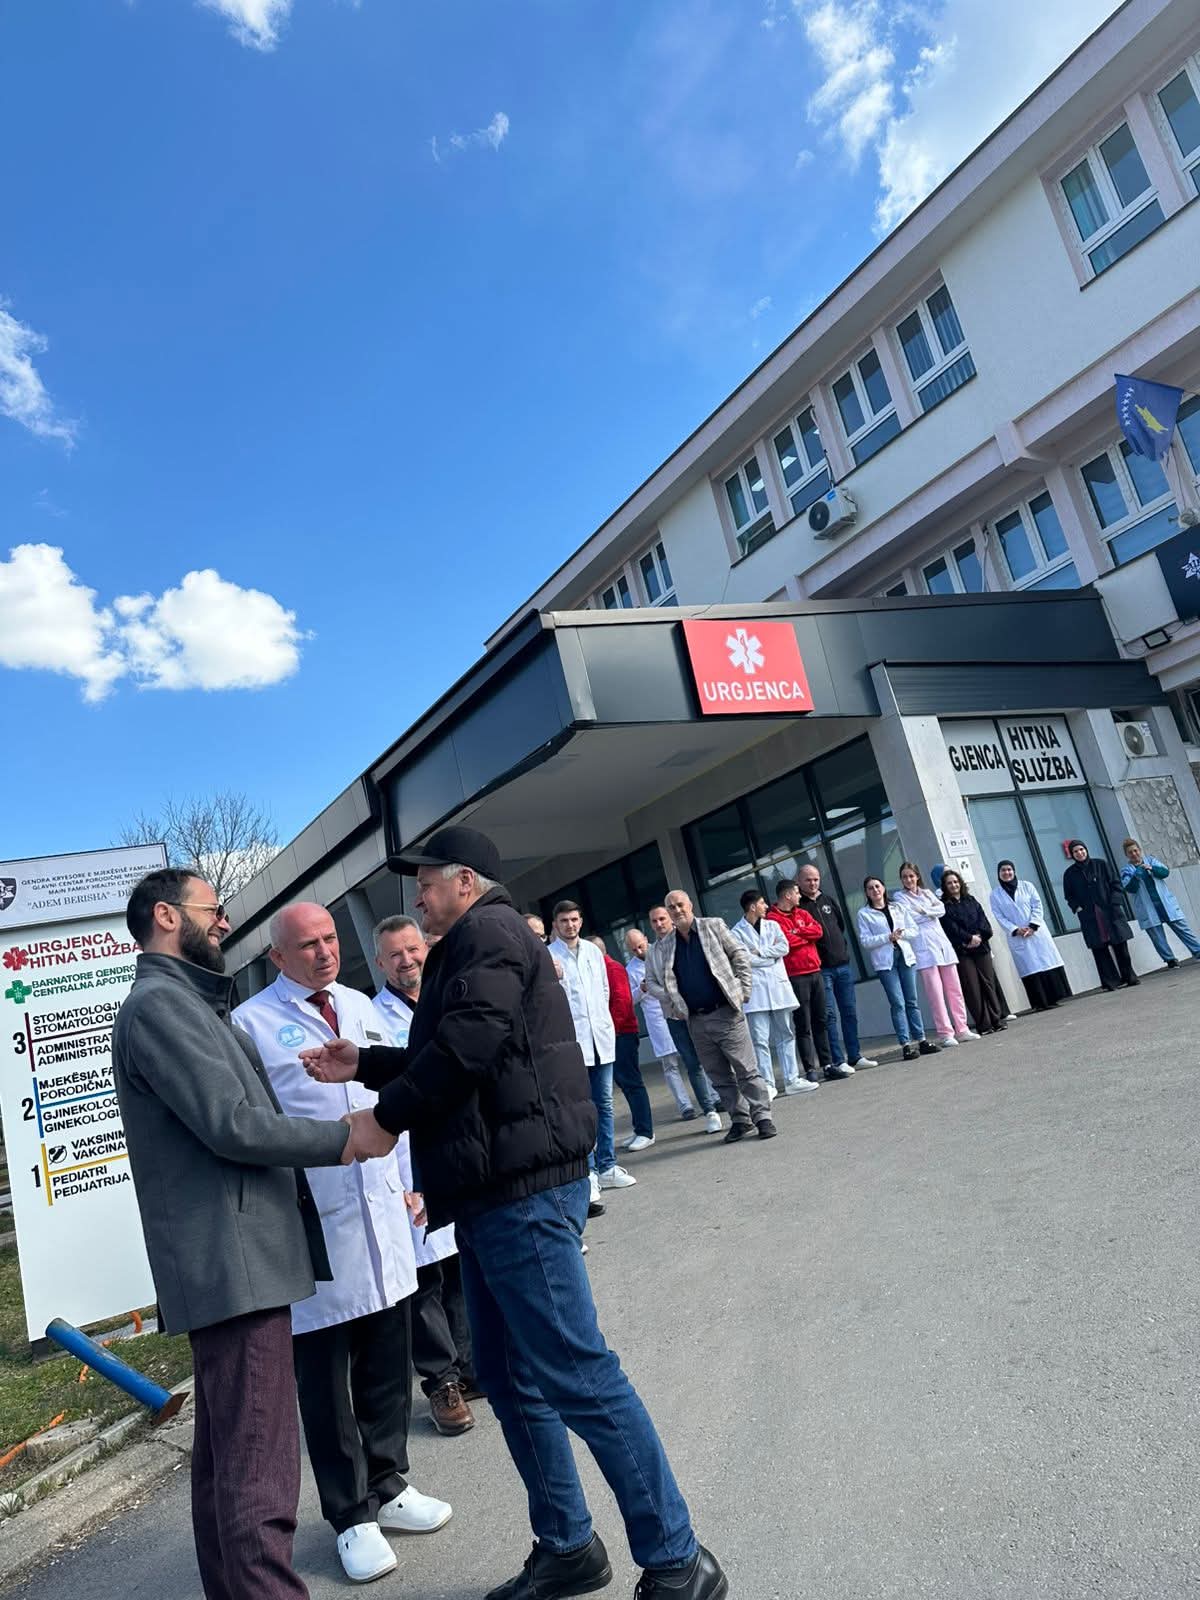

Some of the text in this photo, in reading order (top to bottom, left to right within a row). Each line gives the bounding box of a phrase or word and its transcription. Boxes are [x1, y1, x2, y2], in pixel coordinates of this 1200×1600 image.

[703, 681, 804, 701] URGJENCA
[1006, 725, 1060, 751] HITNA
[948, 743, 1006, 772] GJENCA
[1012, 752, 1078, 783] SLUŽBA
[21, 877, 50, 886] QENDRA
[52, 872, 86, 882] KRYESORE
[32, 883, 57, 891] GLAVNI
[58, 879, 84, 888] CENTAR
[48, 887, 67, 896] MAIN
[67, 885, 90, 893] FAMILY
[91, 881, 116, 890] HEALTH
[27, 932, 115, 955] URGJENCA
[29, 941, 144, 969] HITNA SLUŽBA
[31, 964, 136, 989] BARNATORE QENDRO
[32, 981, 94, 998] CENTRALNA
[12, 1031, 27, 1054] 3
[38, 1068, 99, 1090] MJEKËSIA
[40, 1078, 112, 1101] PORODIČNA
[21, 1097, 36, 1121] 2
[72, 1142, 126, 1161] VAKCINA
[31, 1164, 41, 1188] 1
[52, 1166, 108, 1186] PEDIATRI
[54, 1172, 130, 1199] PEDIJATRIJA
